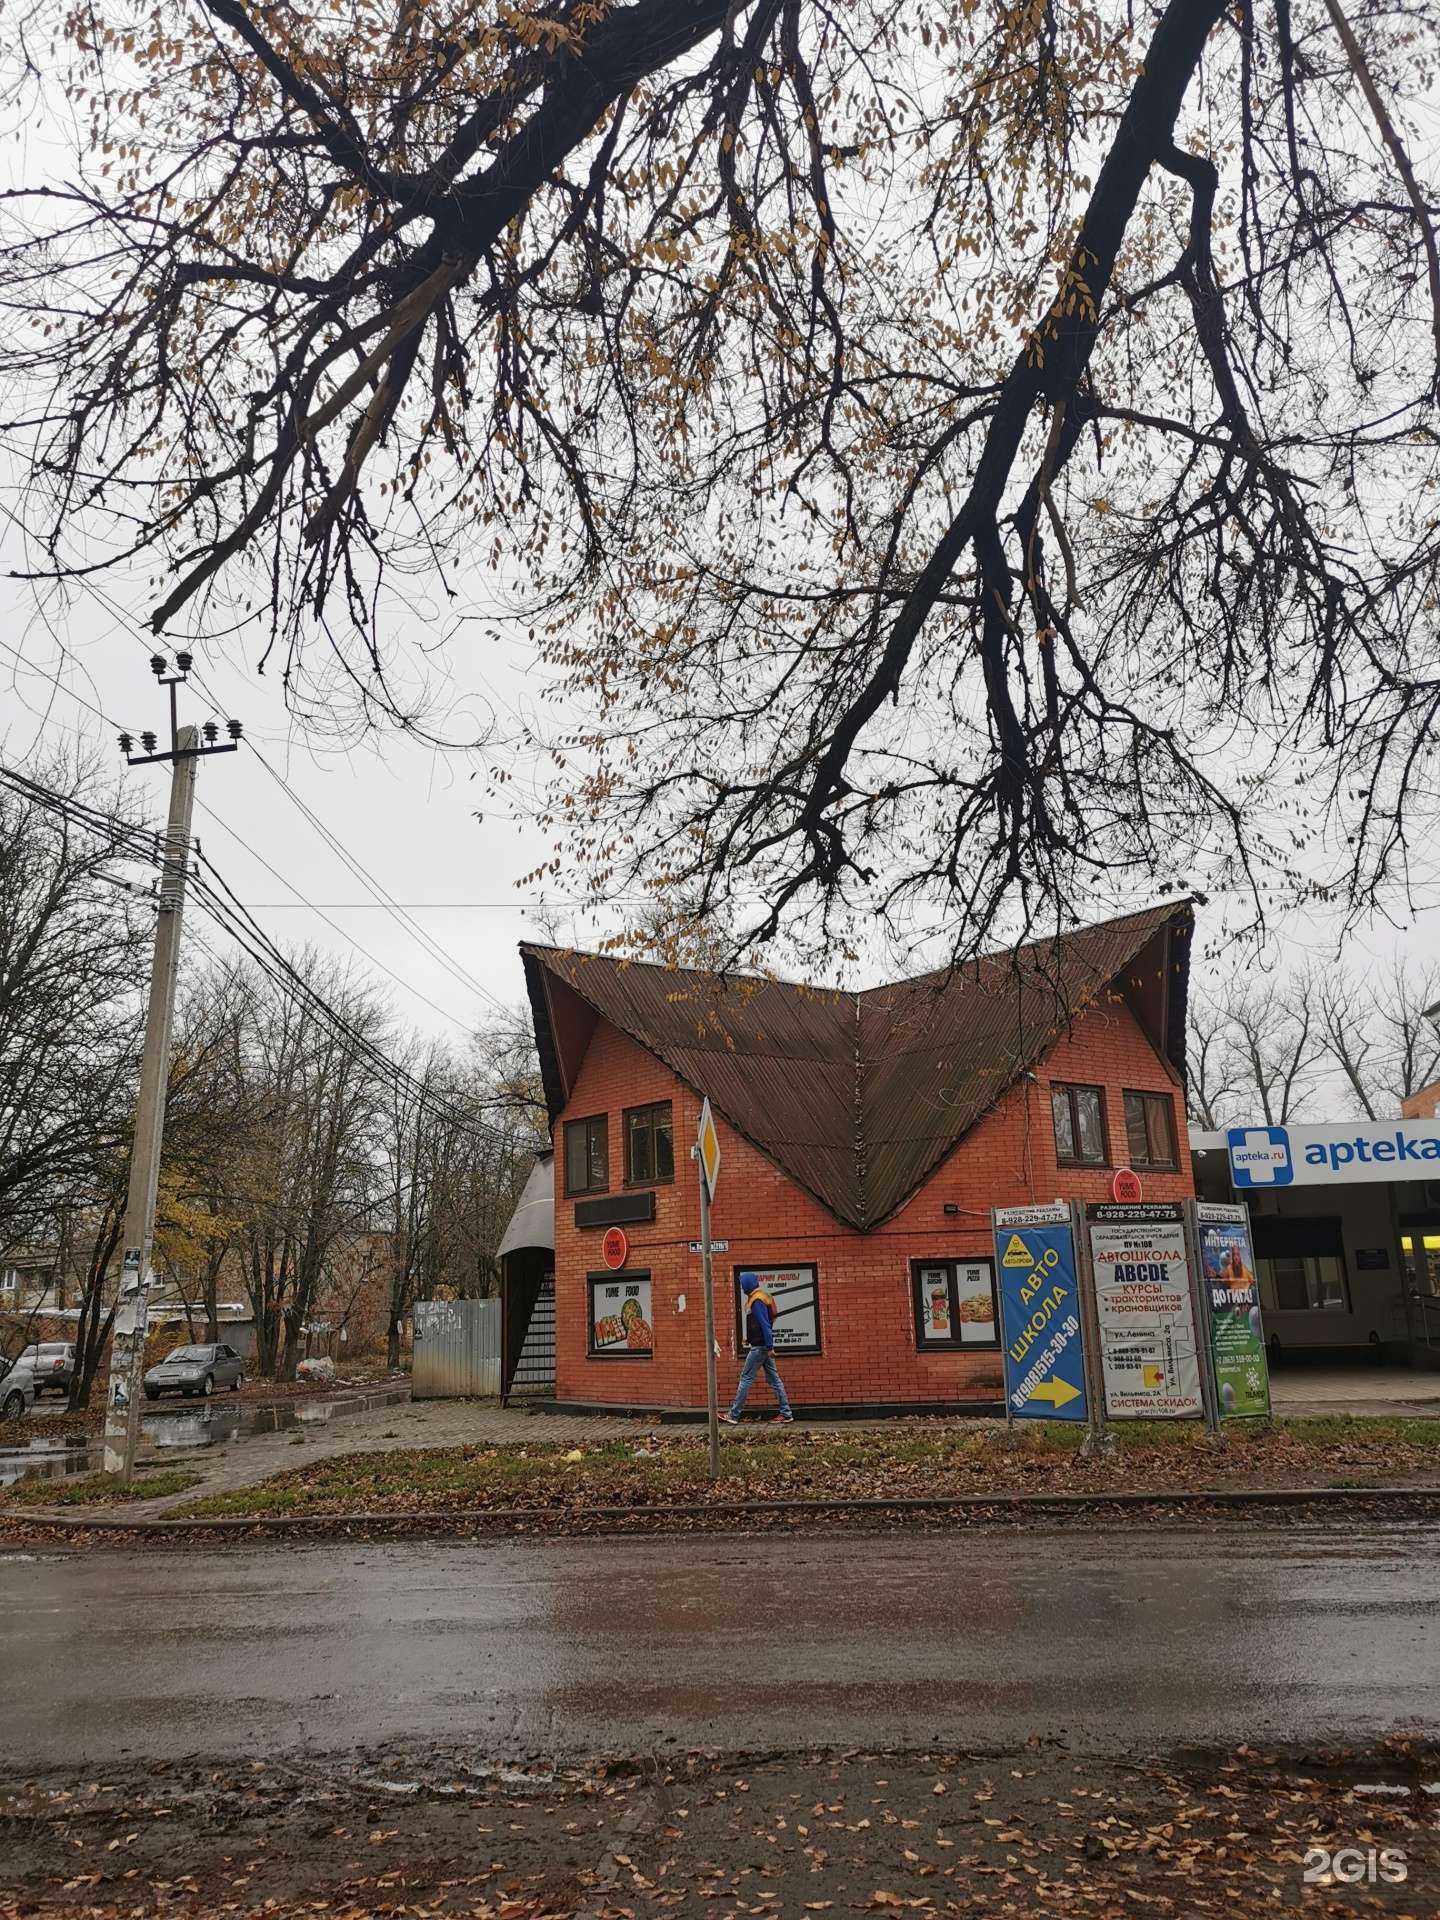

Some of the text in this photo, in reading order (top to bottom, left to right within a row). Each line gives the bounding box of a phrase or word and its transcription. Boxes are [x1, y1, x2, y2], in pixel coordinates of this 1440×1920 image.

[1235, 1152, 1284, 1163] apteka.ru
[1096, 1210, 1177, 1219] 8-928-229-47-75
[1204, 1235, 1246, 1248] ИНТЕРНЕТА
[1098, 1250, 1182, 1263] АВТОШКОЛА
[1020, 1248, 1059, 1306] АВТО
[1114, 1263, 1170, 1283] ABCDE
[625, 1285, 640, 1297] FOOD
[1122, 1284, 1162, 1294] КУРСЫ
[1110, 1294, 1182, 1304] трактористов
[1111, 1304, 1182, 1313] крановщиков
[1010, 1285, 1068, 1363] ШКОЛА
[1011, 1315, 1080, 1409] 8(988)515-30-30
[1111, 1398, 1198, 1408] СИСТЕМА СКИДОК
